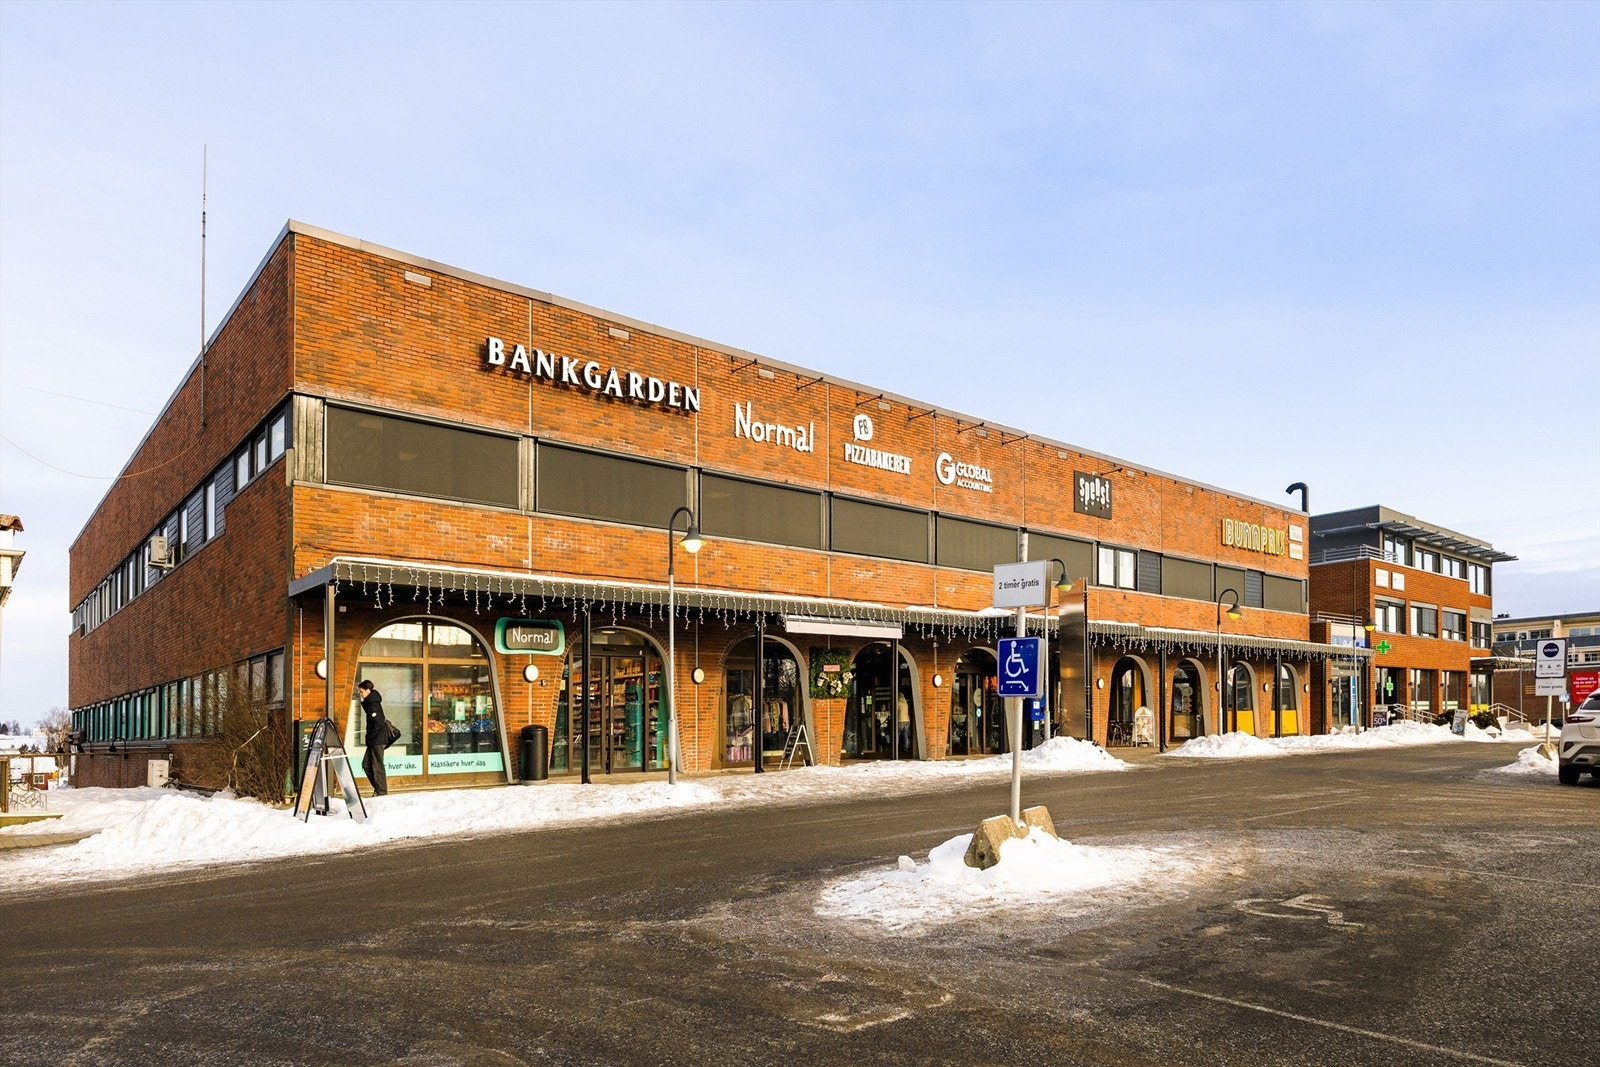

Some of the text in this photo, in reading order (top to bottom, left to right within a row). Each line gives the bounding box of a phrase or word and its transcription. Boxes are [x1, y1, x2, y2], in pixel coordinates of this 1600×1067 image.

[487, 336, 701, 412] BANKGÅRDEN
[735, 401, 814, 453] Normal
[844, 442, 912, 475] PIZZABAKEREN
[956, 461, 993, 483] GLOBAL
[957, 478, 993, 493] ACCOUNTING
[998, 582, 1003, 590] 2
[1021, 579, 1040, 590] gratis
[512, 626, 554, 644] Normal
